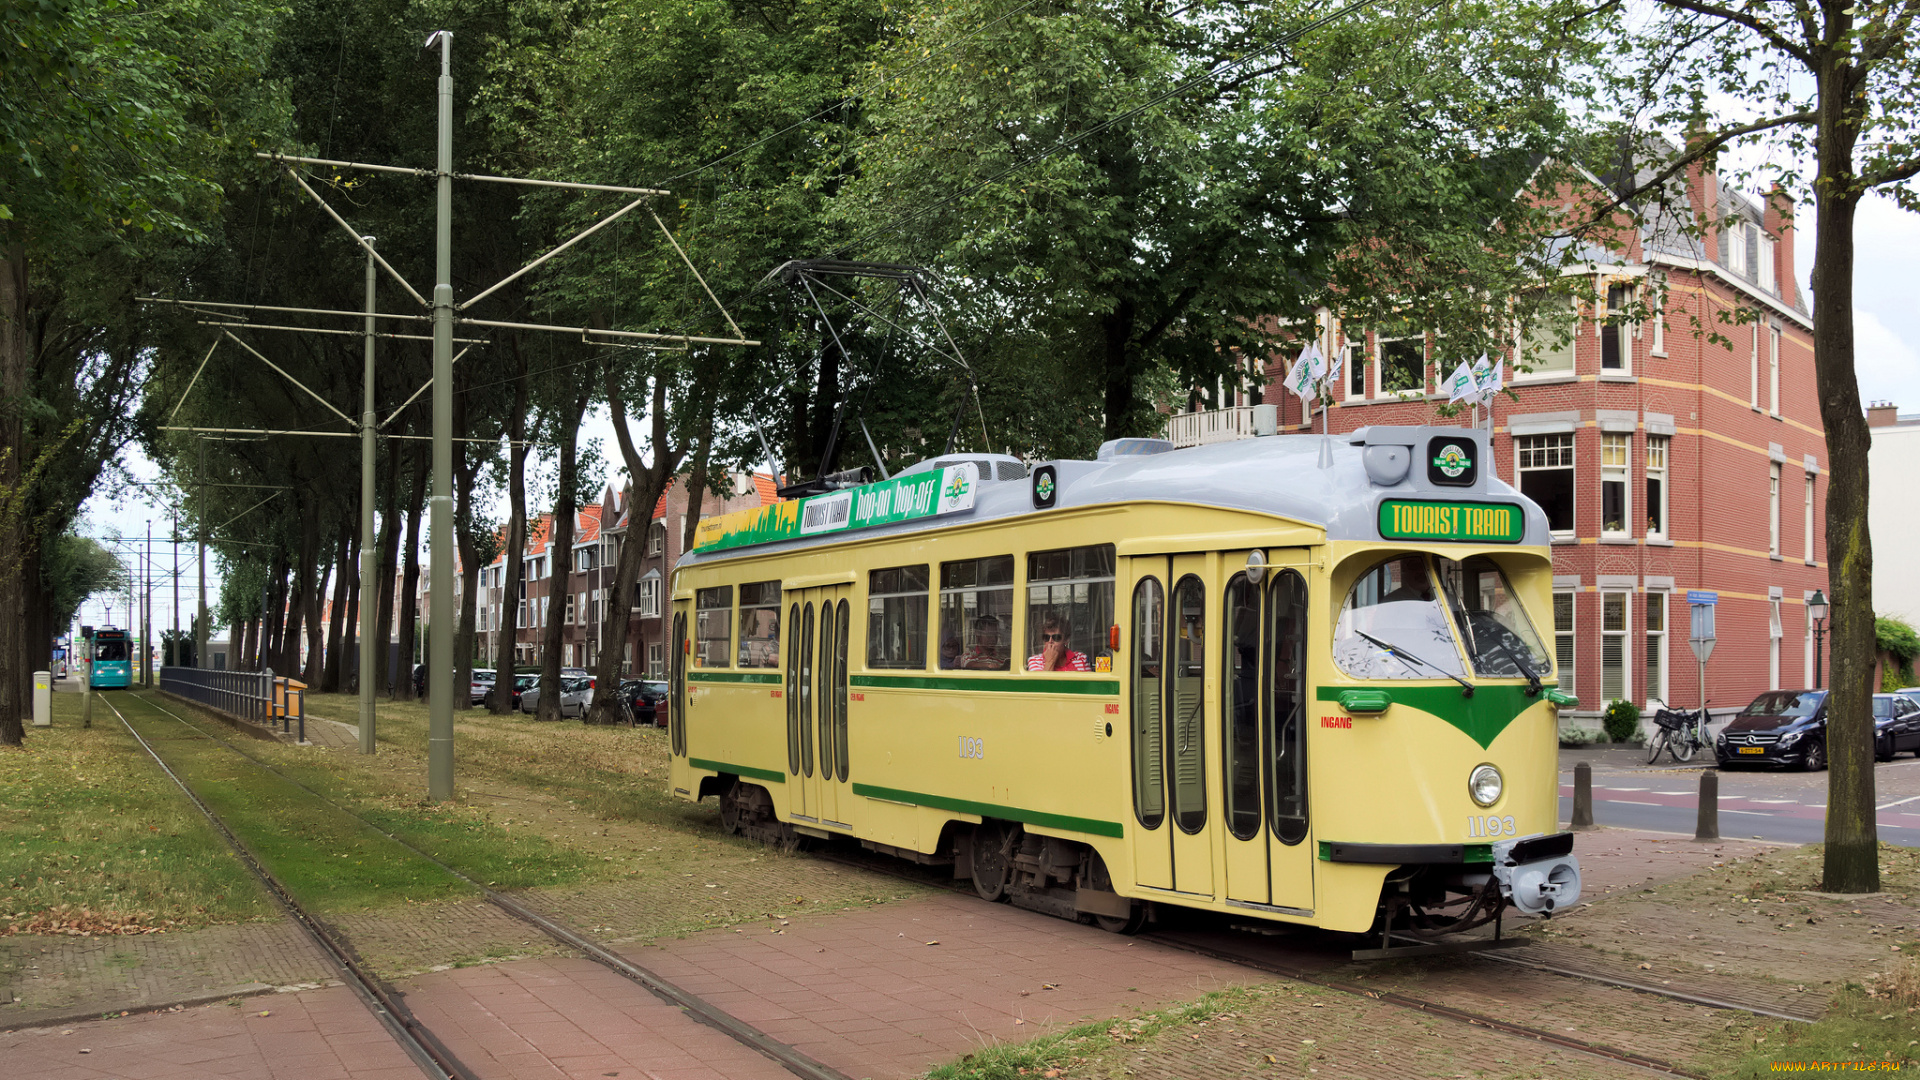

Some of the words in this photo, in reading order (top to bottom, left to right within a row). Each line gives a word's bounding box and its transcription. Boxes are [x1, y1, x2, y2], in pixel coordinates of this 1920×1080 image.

[804, 502, 831, 528] TOURIST
[829, 499, 849, 525] TRAM
[855, 489, 891, 522] hop-on
[893, 479, 936, 517] hop-off
[1392, 505, 1460, 535] TOURIST
[1463, 507, 1510, 536] TRAM
[1320, 716, 1353, 729] INGANG
[958, 735, 984, 759] 1193
[1467, 815, 1517, 838] 1193
